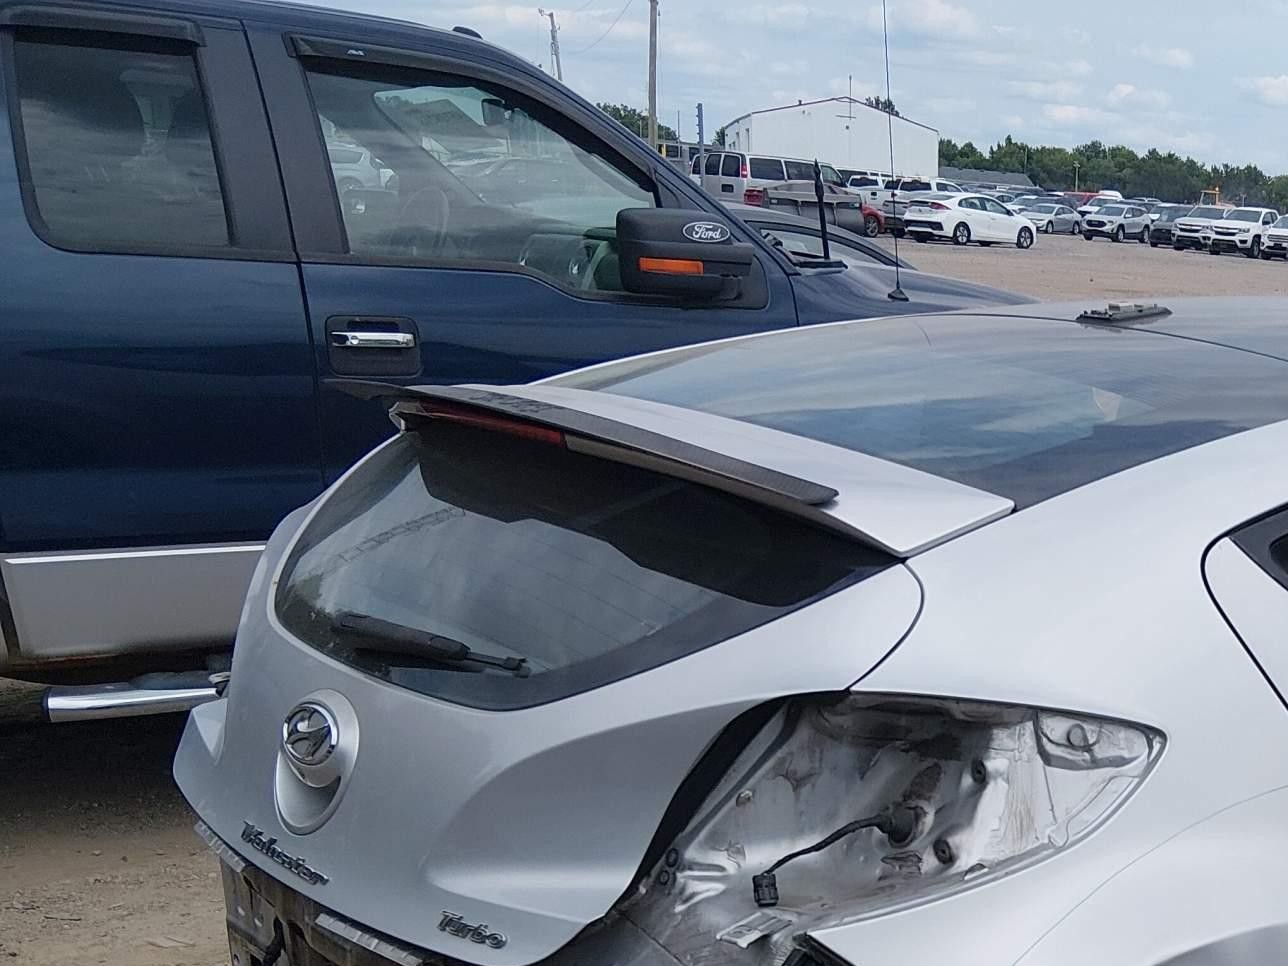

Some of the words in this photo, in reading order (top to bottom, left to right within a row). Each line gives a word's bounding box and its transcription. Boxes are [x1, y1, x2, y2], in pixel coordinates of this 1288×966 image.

[692, 224, 722, 240] Ford
[240, 819, 331, 886] Veloster
[437, 909, 511, 949] Turbo
